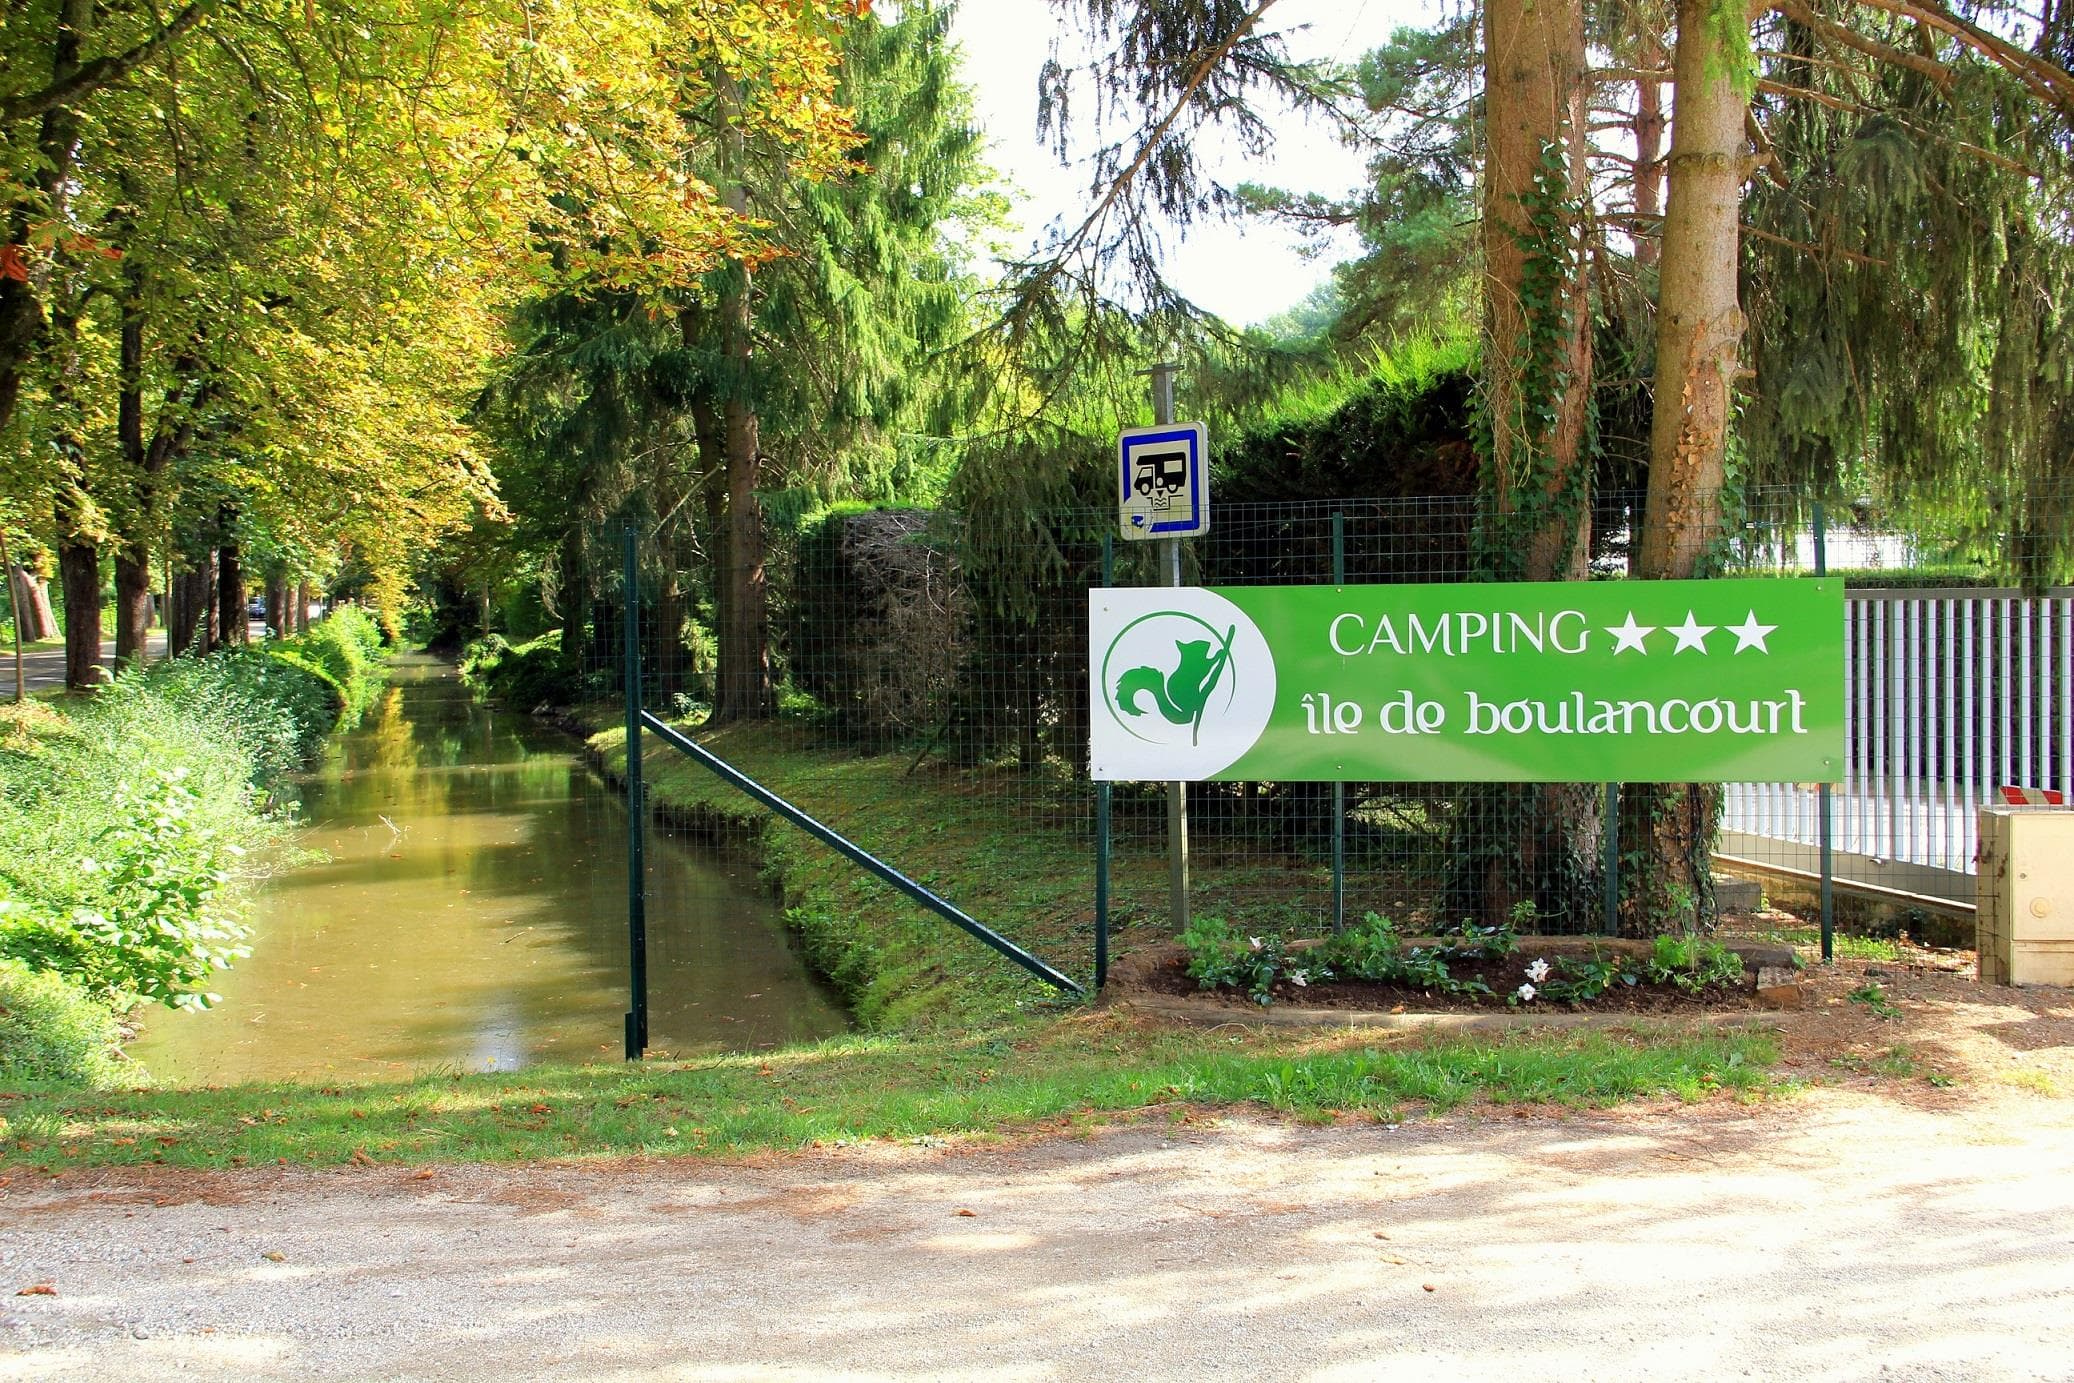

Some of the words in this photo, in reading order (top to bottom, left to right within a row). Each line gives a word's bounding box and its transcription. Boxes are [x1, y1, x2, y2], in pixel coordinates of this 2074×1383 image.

[1329, 609, 1591, 656] CAMPING
[1301, 692, 1363, 735] île
[1379, 689, 1445, 735] de
[1463, 689, 1808, 735] boulancourt
